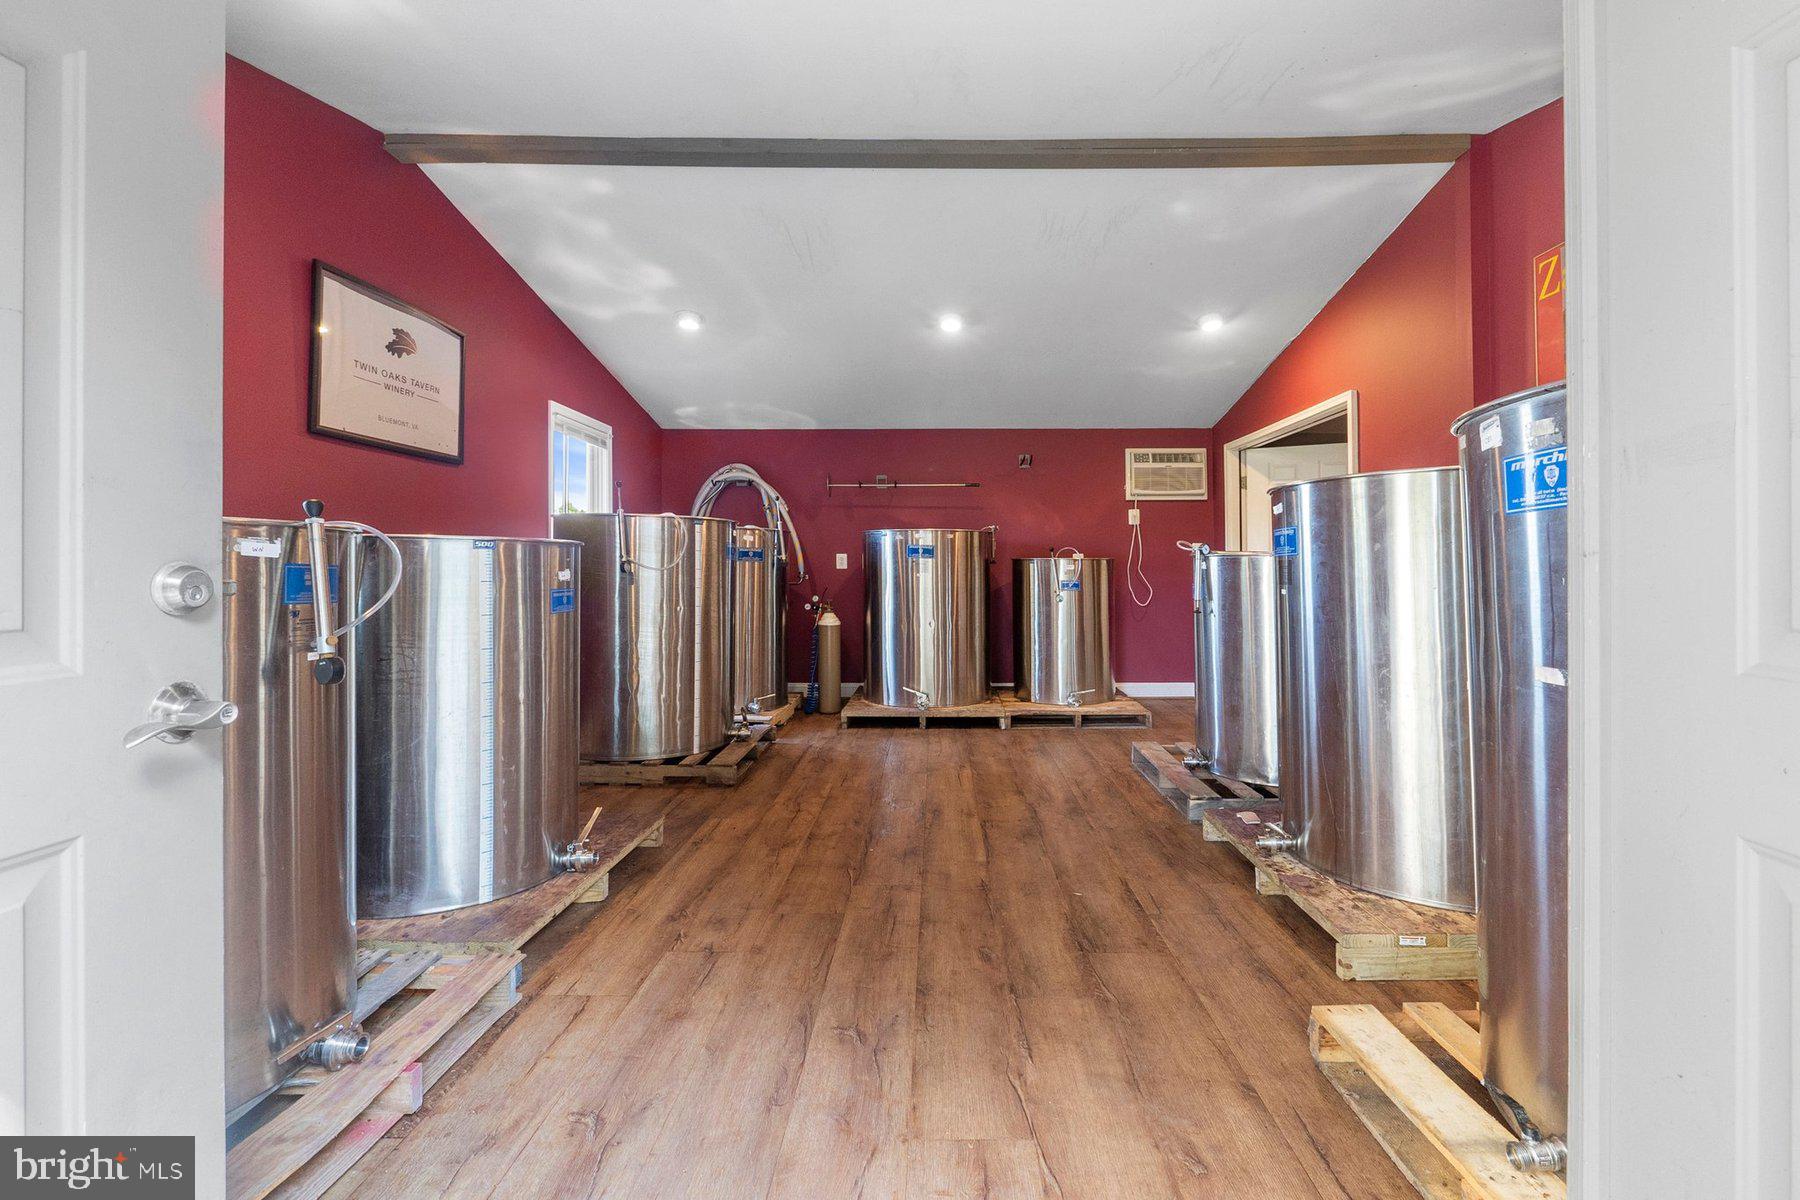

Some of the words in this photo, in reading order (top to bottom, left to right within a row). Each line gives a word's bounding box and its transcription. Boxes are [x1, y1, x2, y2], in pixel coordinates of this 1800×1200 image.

[1538, 254, 1566, 301] Z
[354, 359, 378, 375] TWIN
[381, 370, 407, 384] OAKS
[410, 378, 440, 394] TAVERN
[383, 383, 415, 398] WINERY
